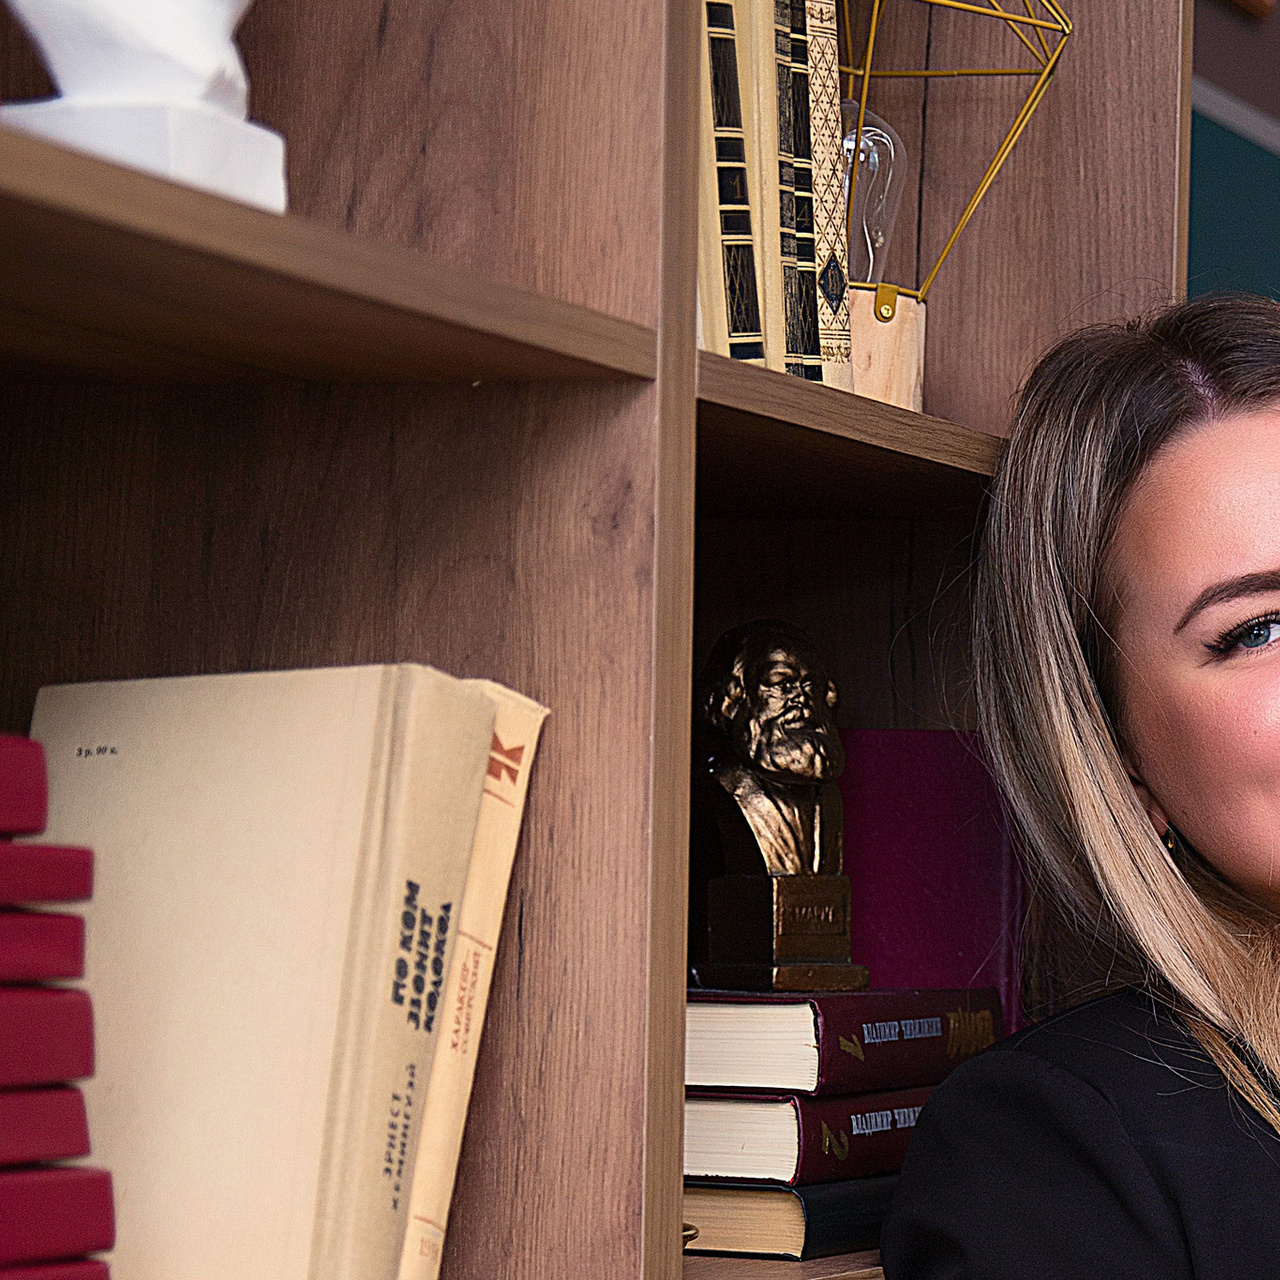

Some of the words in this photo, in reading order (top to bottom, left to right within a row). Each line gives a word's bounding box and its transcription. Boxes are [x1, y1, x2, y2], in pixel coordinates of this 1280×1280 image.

[391, 957, 408, 1007] ПО
[400, 879, 420, 952] КОМ
[407, 907, 433, 1030] ЗВОНИТ
[423, 901, 452, 1034] КОЛОКОЛ
[383, 1092, 401, 1179] ЭРНЕСТ
